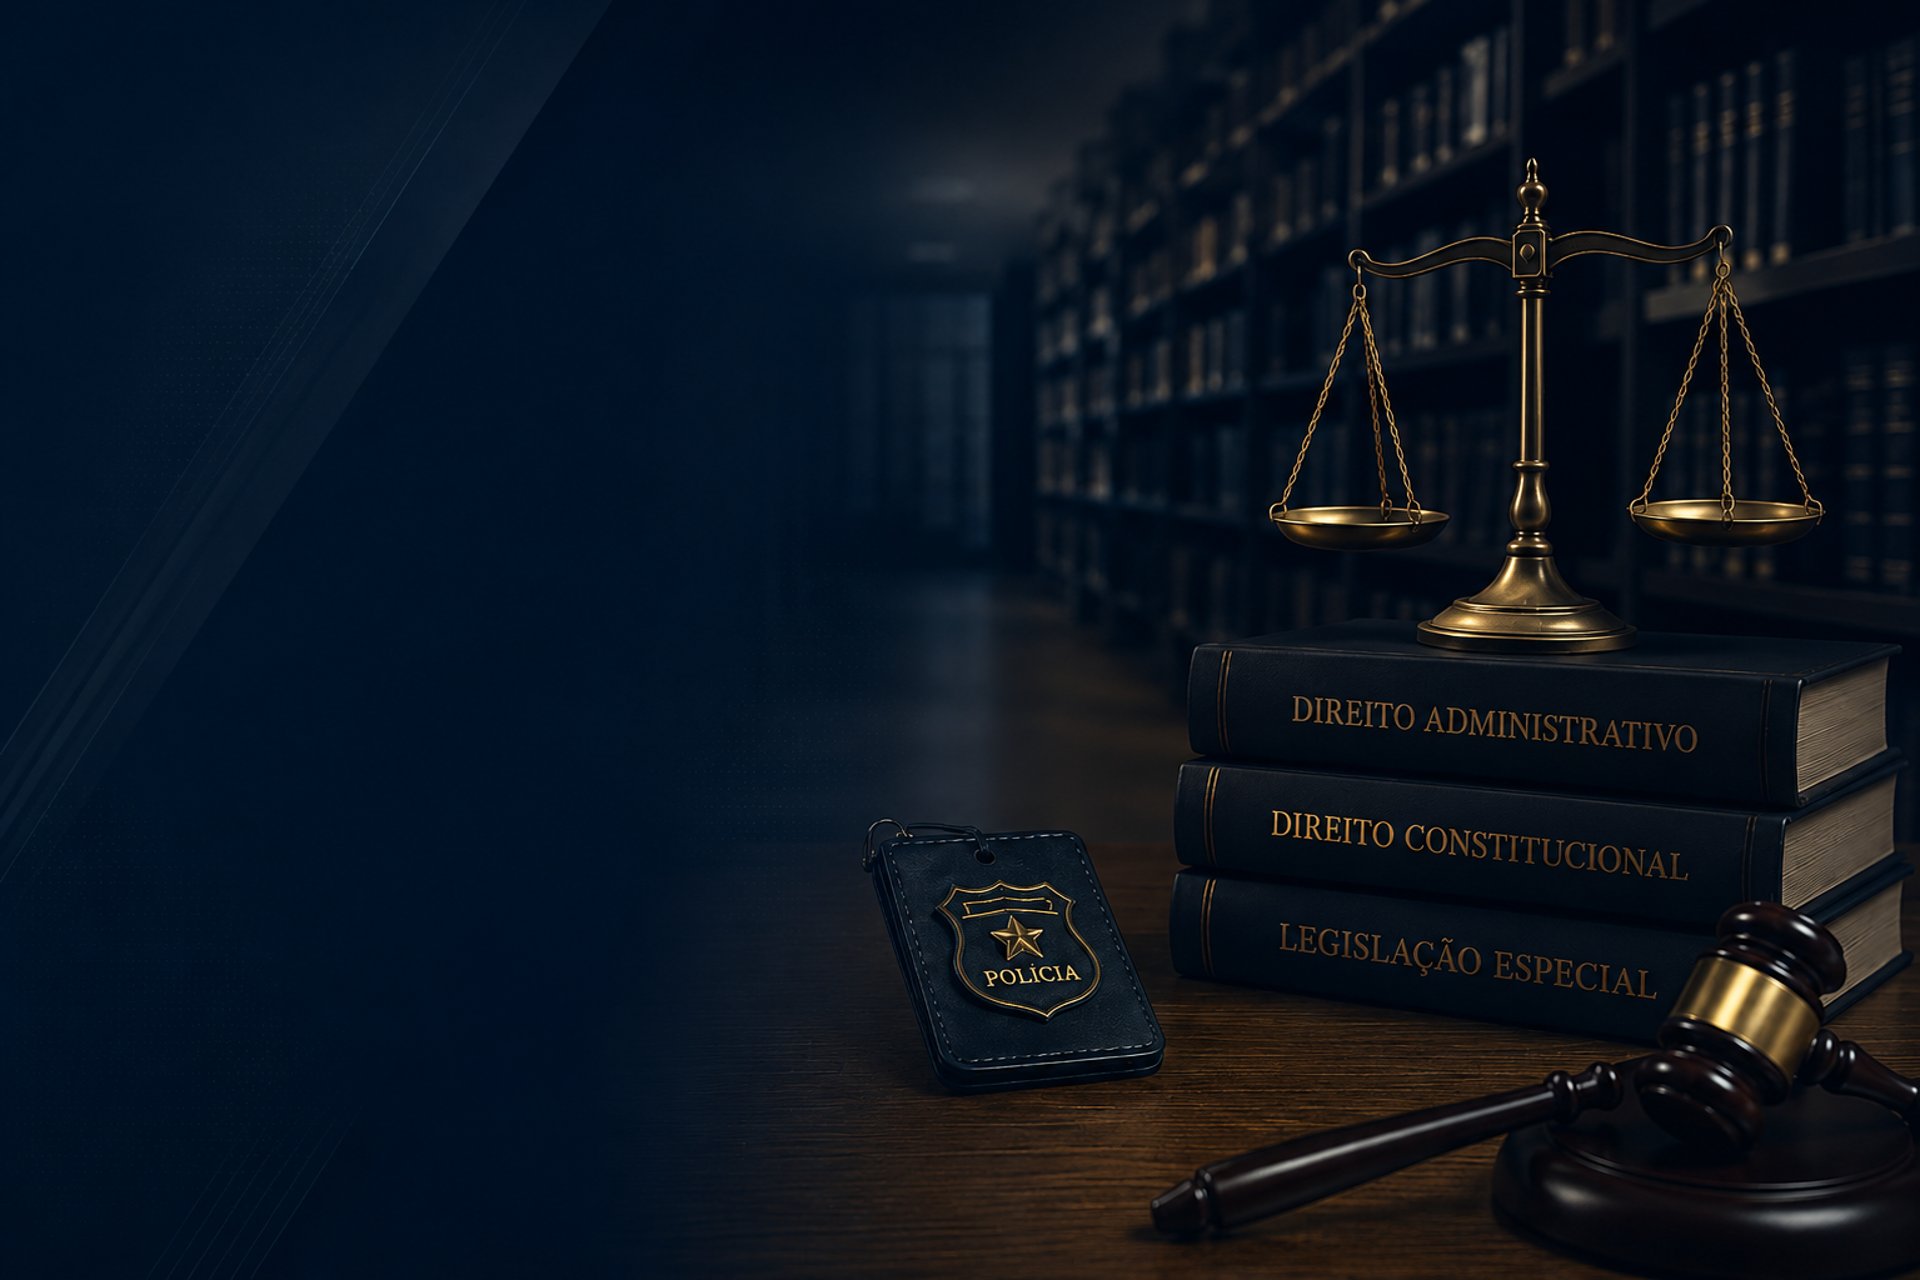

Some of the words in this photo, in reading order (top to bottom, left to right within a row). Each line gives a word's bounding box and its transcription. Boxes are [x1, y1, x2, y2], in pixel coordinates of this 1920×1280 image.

[1291, 695, 1415, 731] DIREITO
[1423, 706, 1698, 754] ADMINISTRATIVO
[1271, 810, 1394, 848] DIREITO
[1405, 823, 1689, 881] CONSTITUCIONAL
[1279, 922, 1482, 977] LEGISLAÇÃO
[1493, 950, 1658, 1000] ESPECIAL
